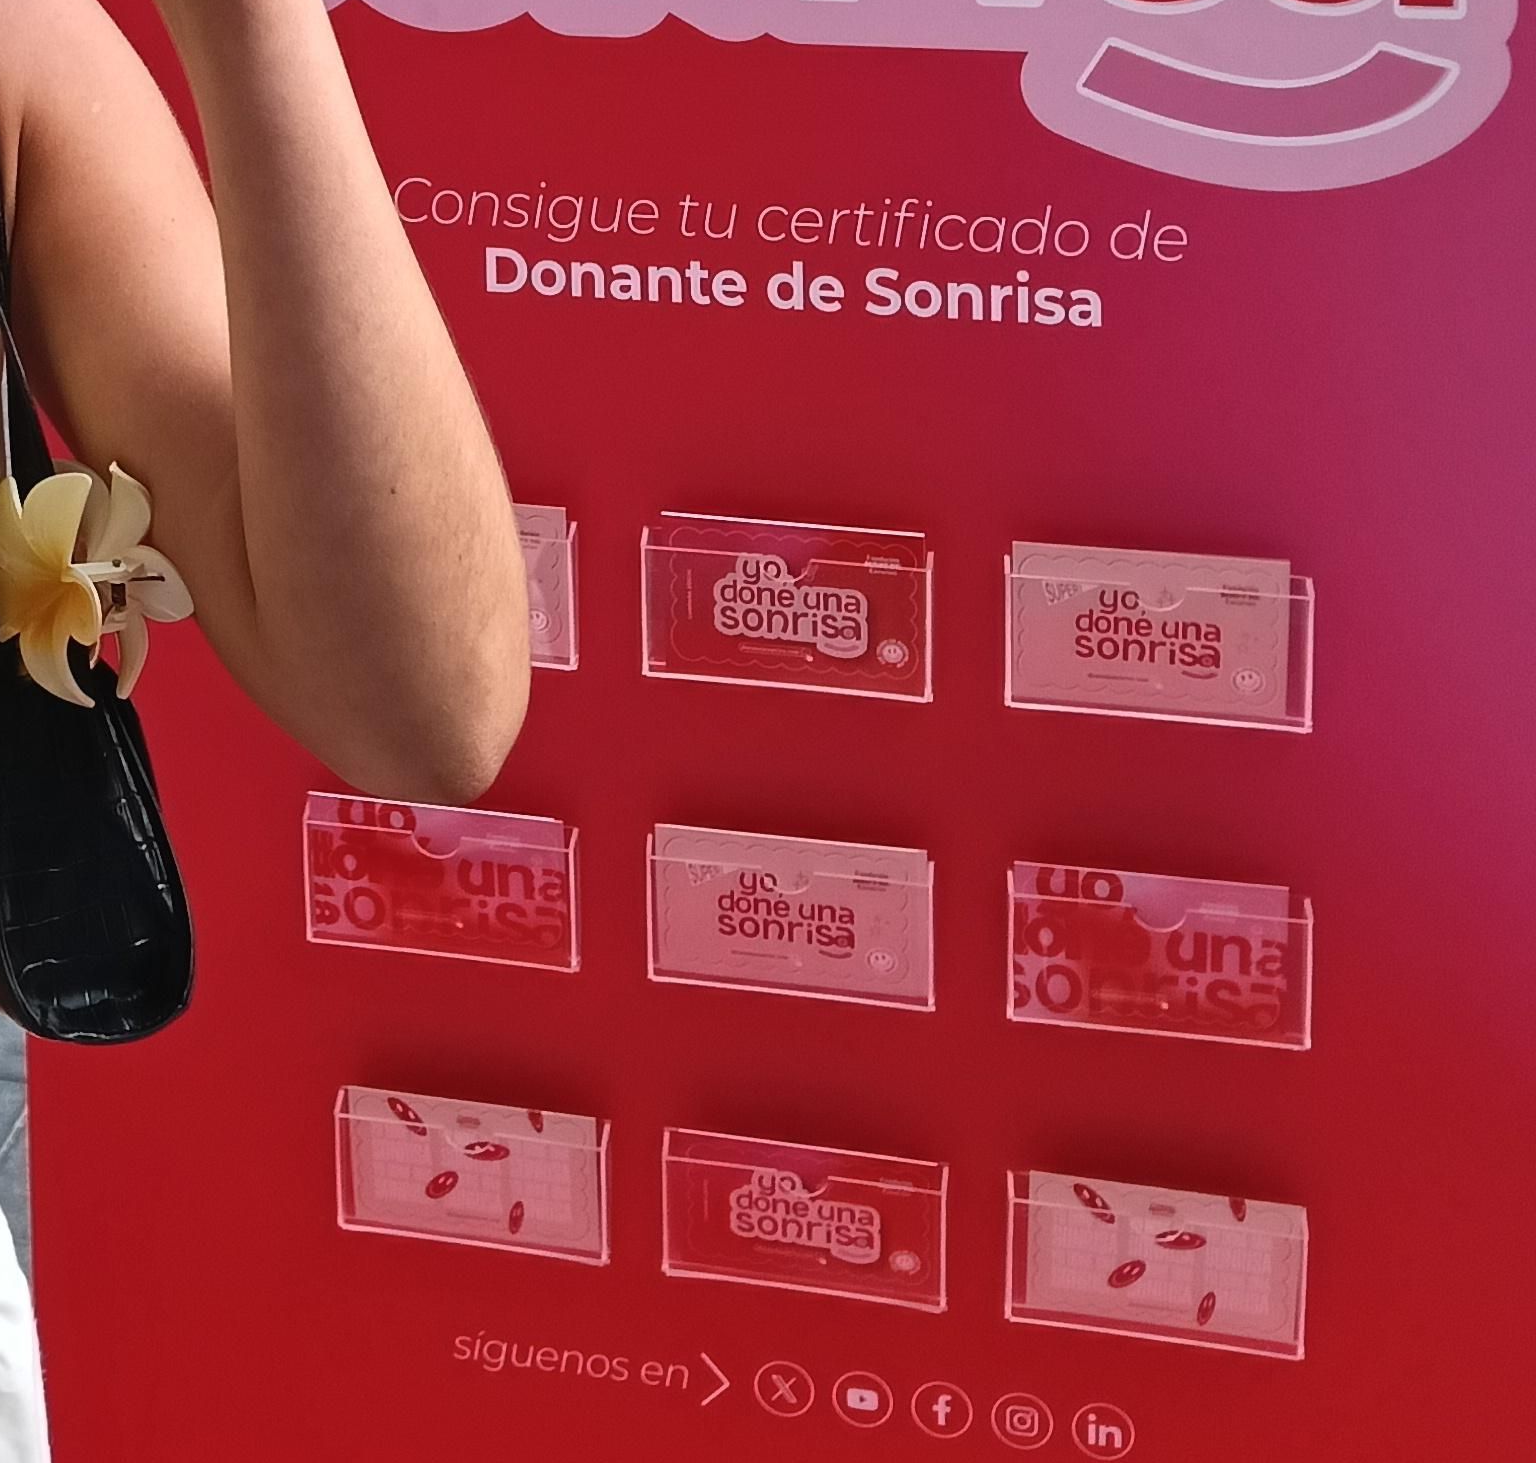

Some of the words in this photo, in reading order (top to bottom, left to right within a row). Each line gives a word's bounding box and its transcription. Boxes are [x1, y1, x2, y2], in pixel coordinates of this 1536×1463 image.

[392, 176, 661, 243] Consigue
[678, 192, 739, 239] tu
[756, 197, 1091, 257] certificado
[1108, 209, 1189, 263] de
[484, 246, 748, 308] Donante
[765, 260, 846, 314] de
[864, 266, 1104, 330] Sonrisa
[742, 558, 781, 584] yo
[803, 591, 861, 615] una
[1099, 589, 1140, 614] yo
[720, 605, 862, 641] sonrisa
[1075, 610, 1152, 637] doné
[1161, 620, 1221, 642] una
[1075, 634, 1221, 669] sonrisa
[739, 871, 777, 895] yo
[798, 903, 855, 925] una
[718, 914, 855, 949] sonrisa
[757, 1172, 797, 1196] yo
[736, 1210, 875, 1250] sonrisa
[817, 1202, 874, 1227] una
[453, 1329, 631, 1383] síguenos
[639, 1357, 691, 1391] en
